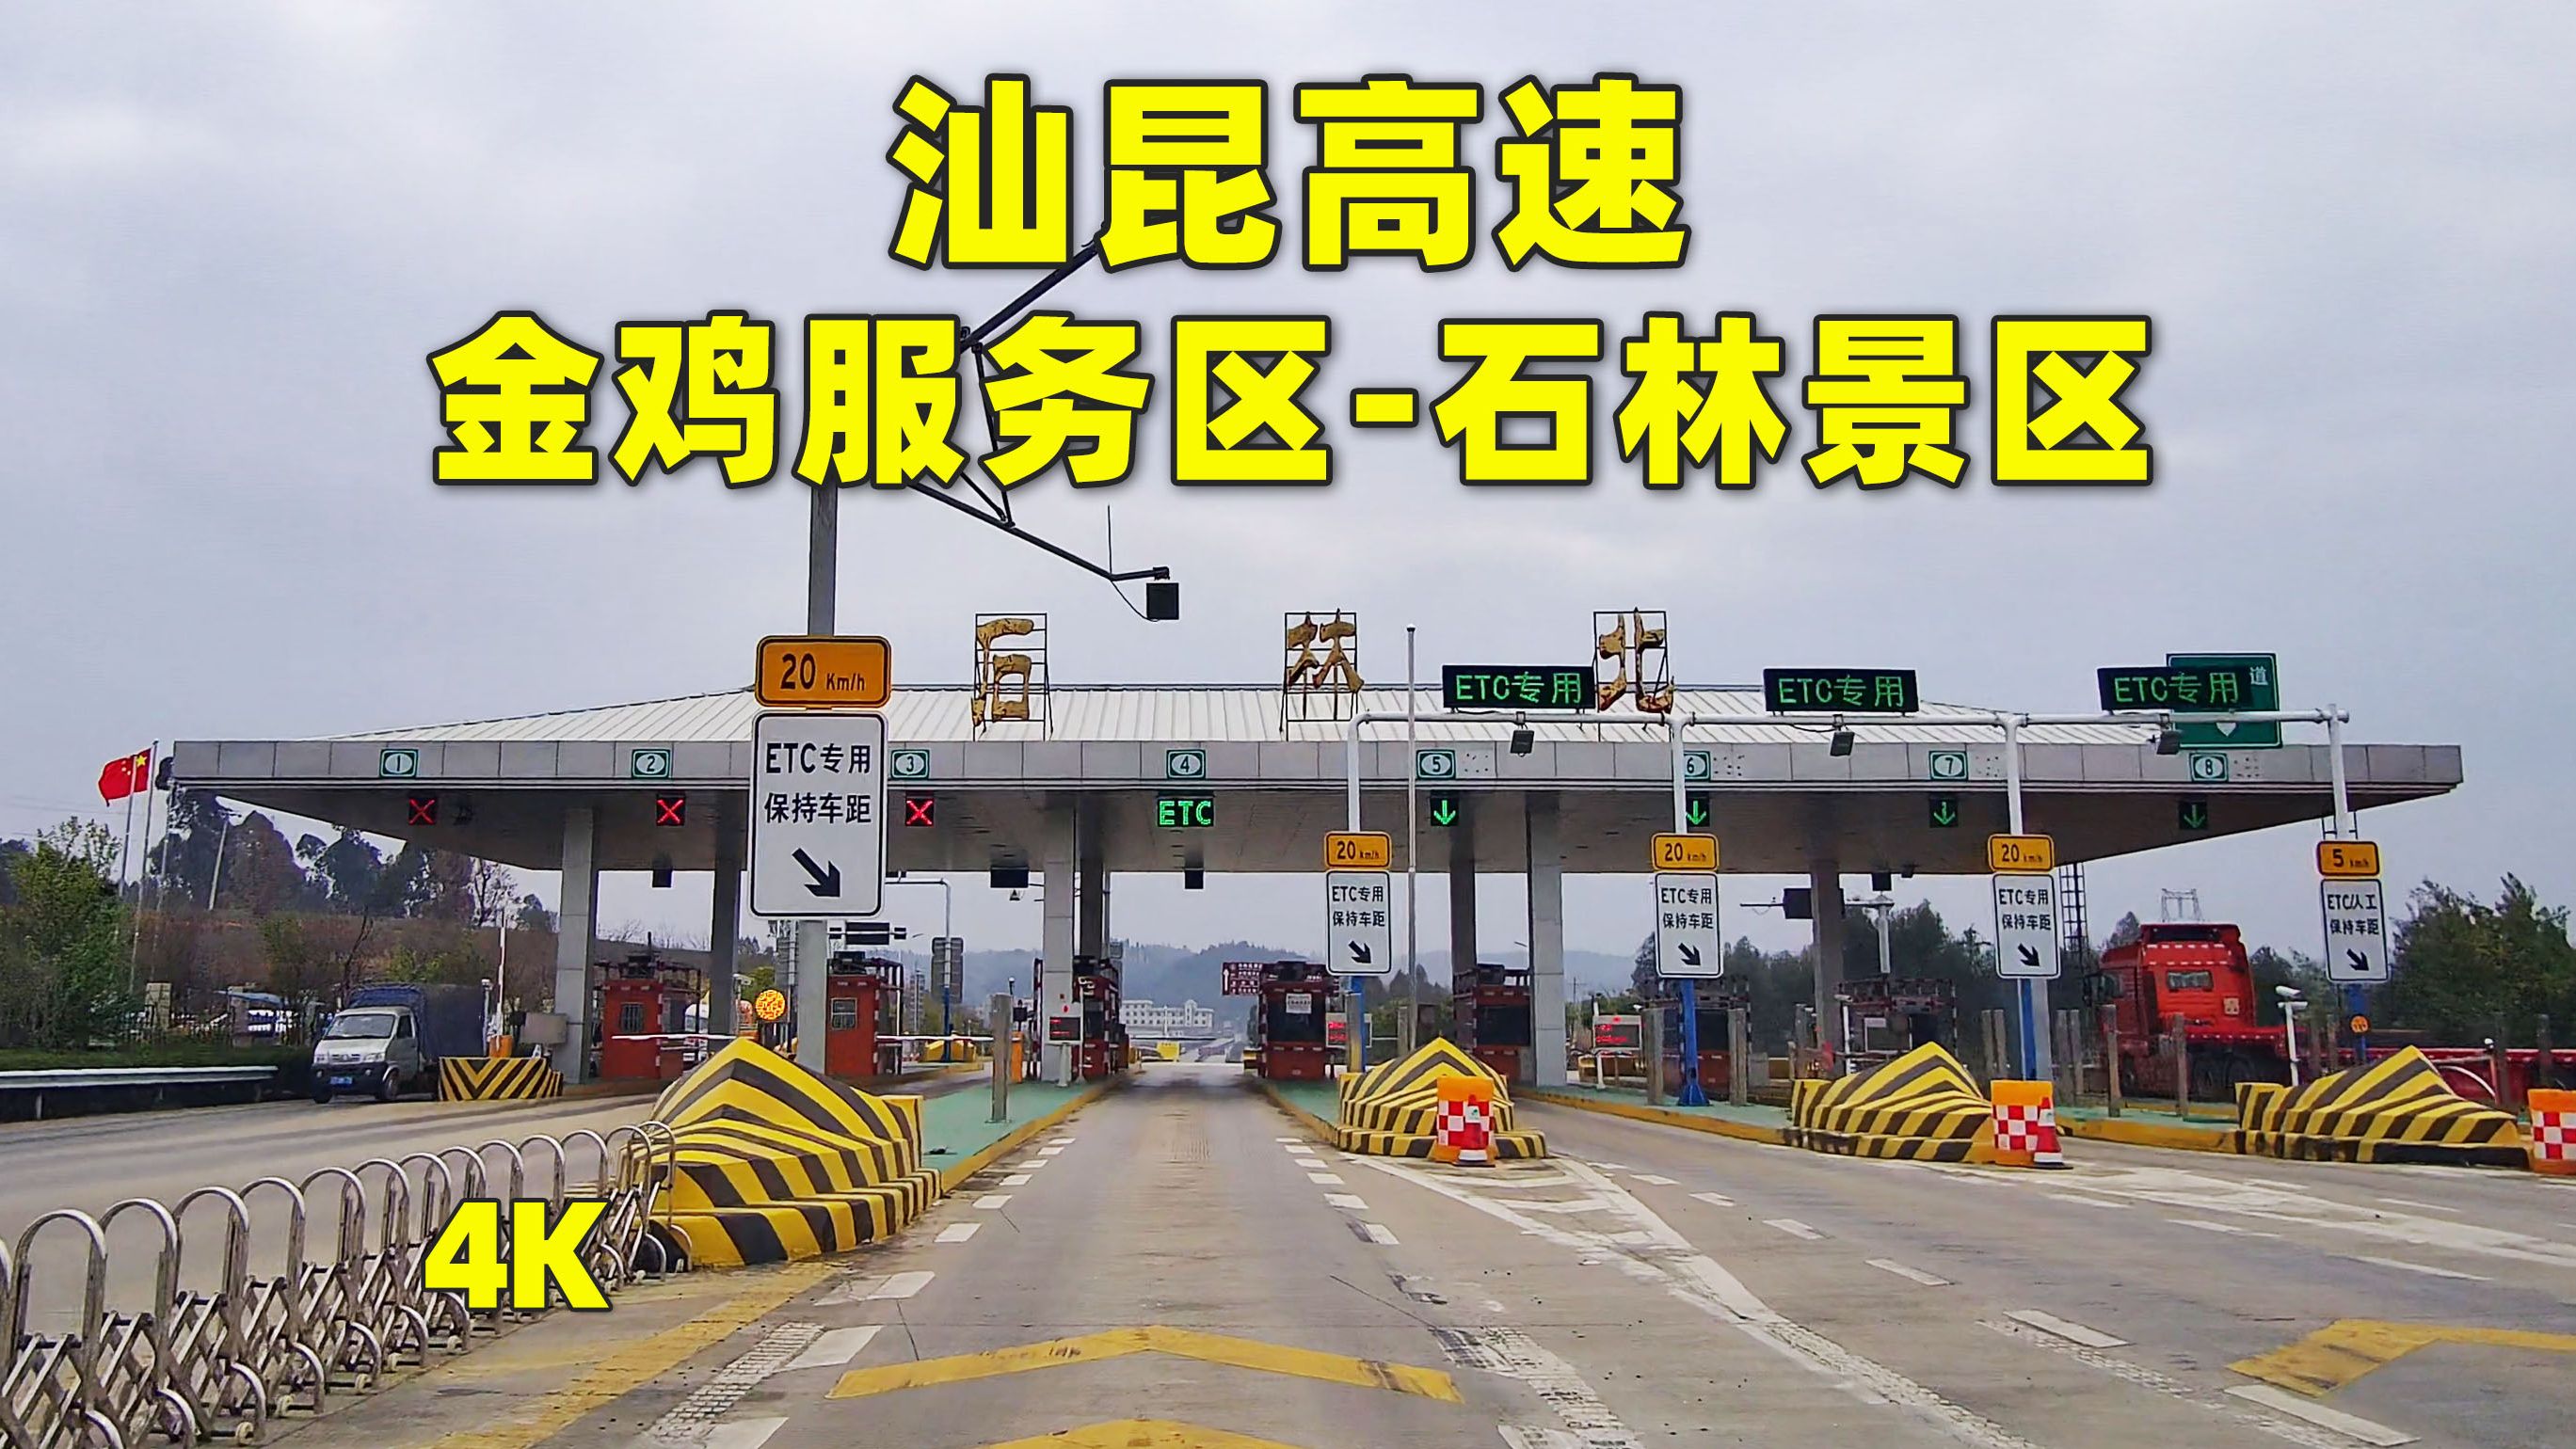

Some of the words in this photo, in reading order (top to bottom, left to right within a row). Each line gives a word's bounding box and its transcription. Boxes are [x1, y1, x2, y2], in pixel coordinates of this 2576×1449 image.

[779, 653, 816, 690] 20
[826, 673, 865, 691] Km/h
[1456, 671, 1582, 704] ETC专用
[1778, 675, 1904, 708] ETC专用
[2114, 672, 2239, 704] ETC专用
[646, 755, 656, 772] 2
[765, 742, 872, 774] ETC专用
[905, 756, 915, 772] 3
[1179, 756, 1190, 773] 4
[1432, 756, 1442, 772] 5
[1686, 756, 1695, 774] 6
[1944, 756, 1954, 775] 7
[2204, 758, 2214, 776] 8
[763, 791, 872, 824] 保持车距
[1159, 800, 1212, 825] ETC
[1336, 840, 1356, 860] 20
[1664, 842, 1683, 862] 20
[2001, 843, 2020, 863] 20
[2332, 849, 2344, 868] 5
[1332, 885, 1384, 902] ETC专用
[1661, 887, 1712, 904] ETC专用
[1998, 888, 2049, 905] ETC专用
[1333, 910, 1385, 927] 保持车距
[1662, 912, 1714, 929] 保持车距
[2002, 914, 2052, 931] 保持车距
[2329, 918, 2380, 935] 保持车距
